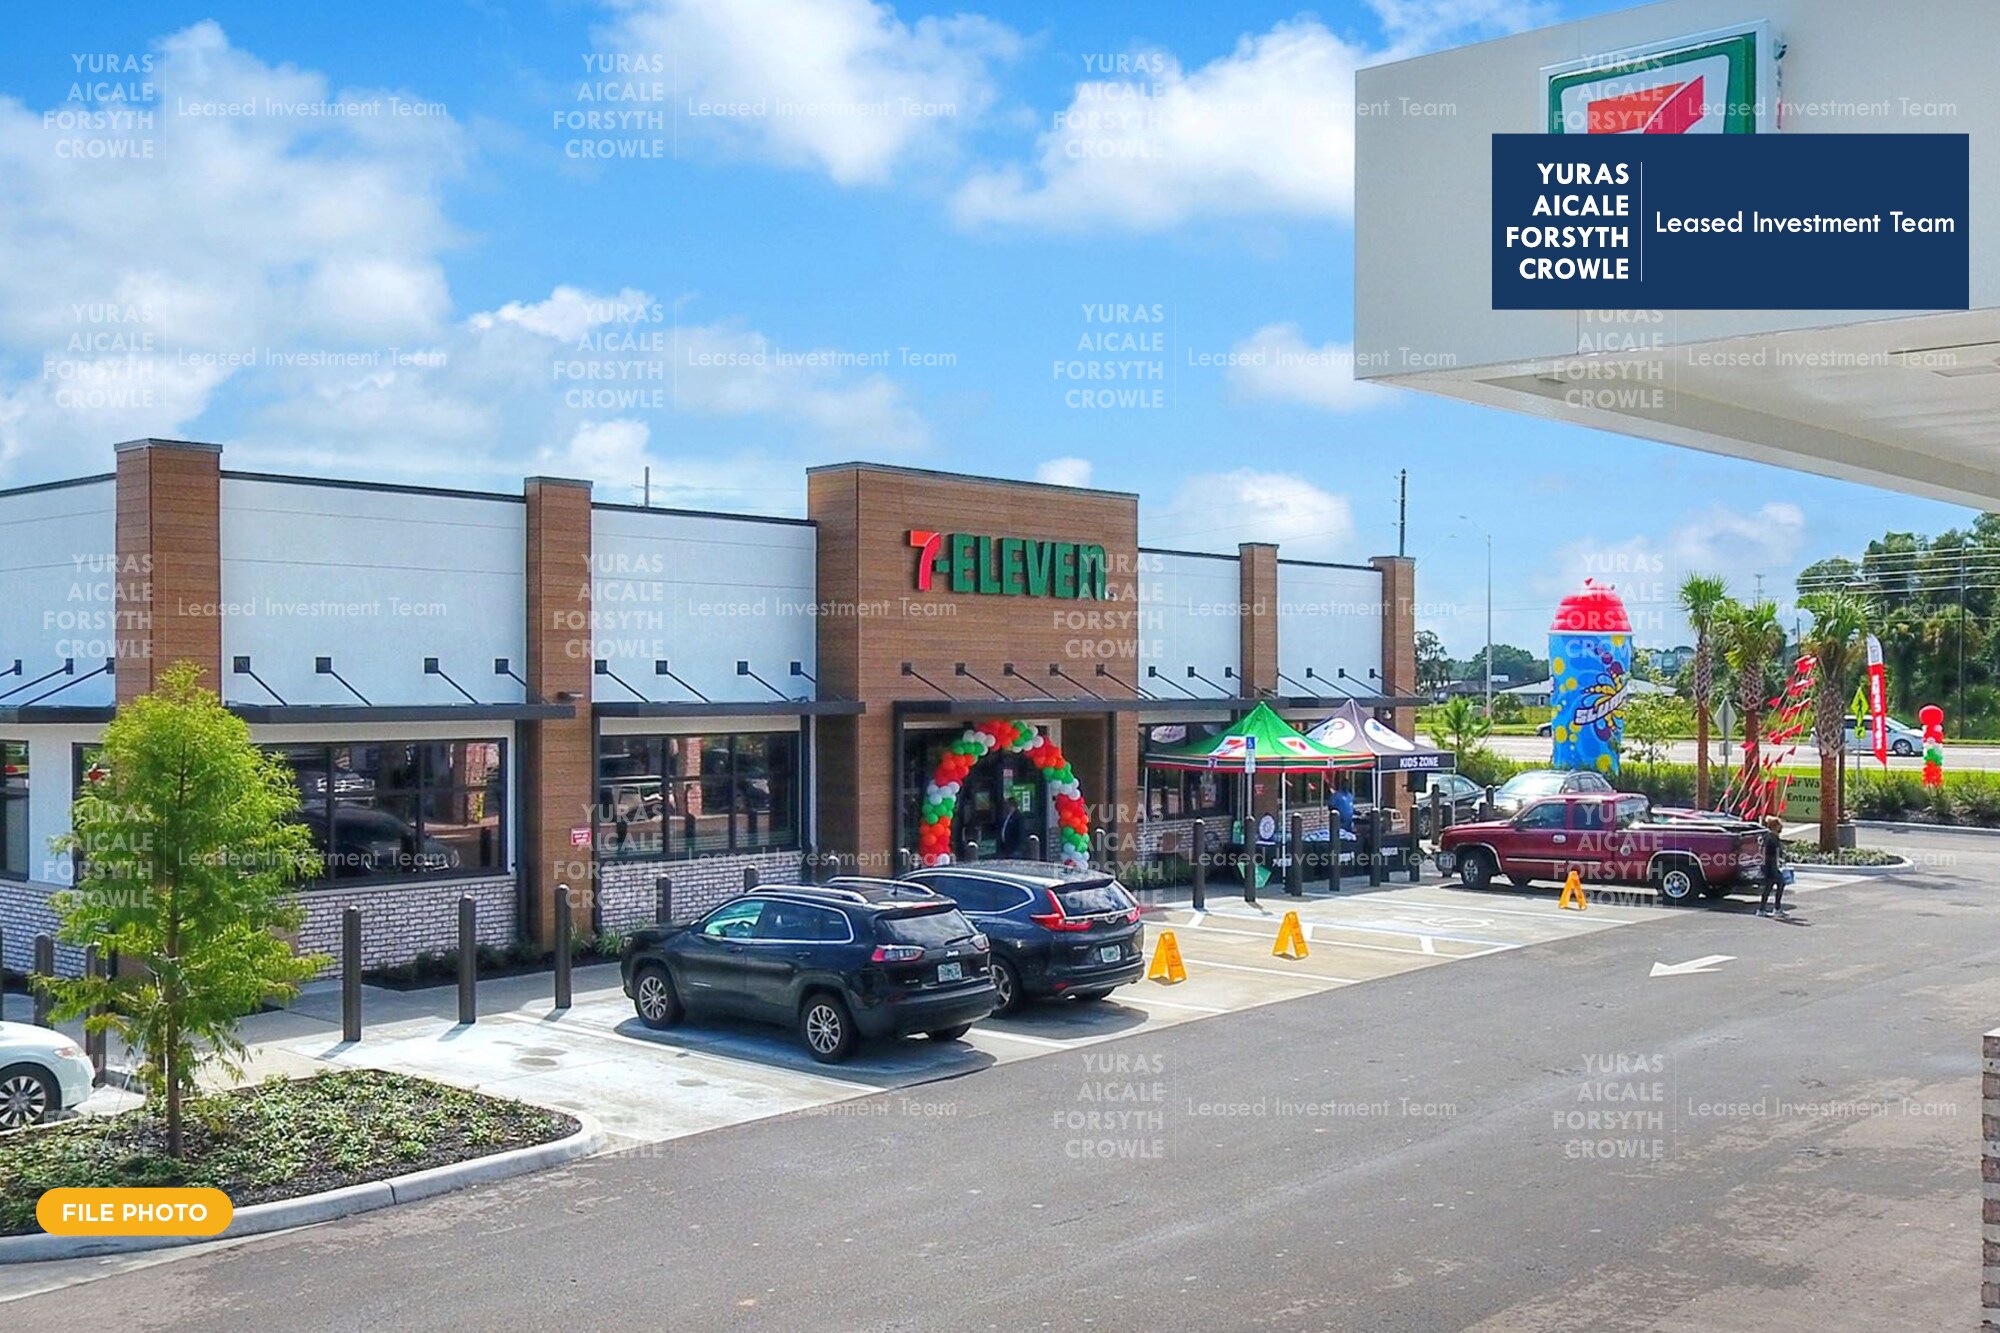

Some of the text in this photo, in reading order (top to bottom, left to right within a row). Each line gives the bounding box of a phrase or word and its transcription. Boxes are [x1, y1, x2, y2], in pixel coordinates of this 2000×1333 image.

[1400, 756, 1439, 768] KIDS ZONE
[1786, 792, 1820, 802] Entran
